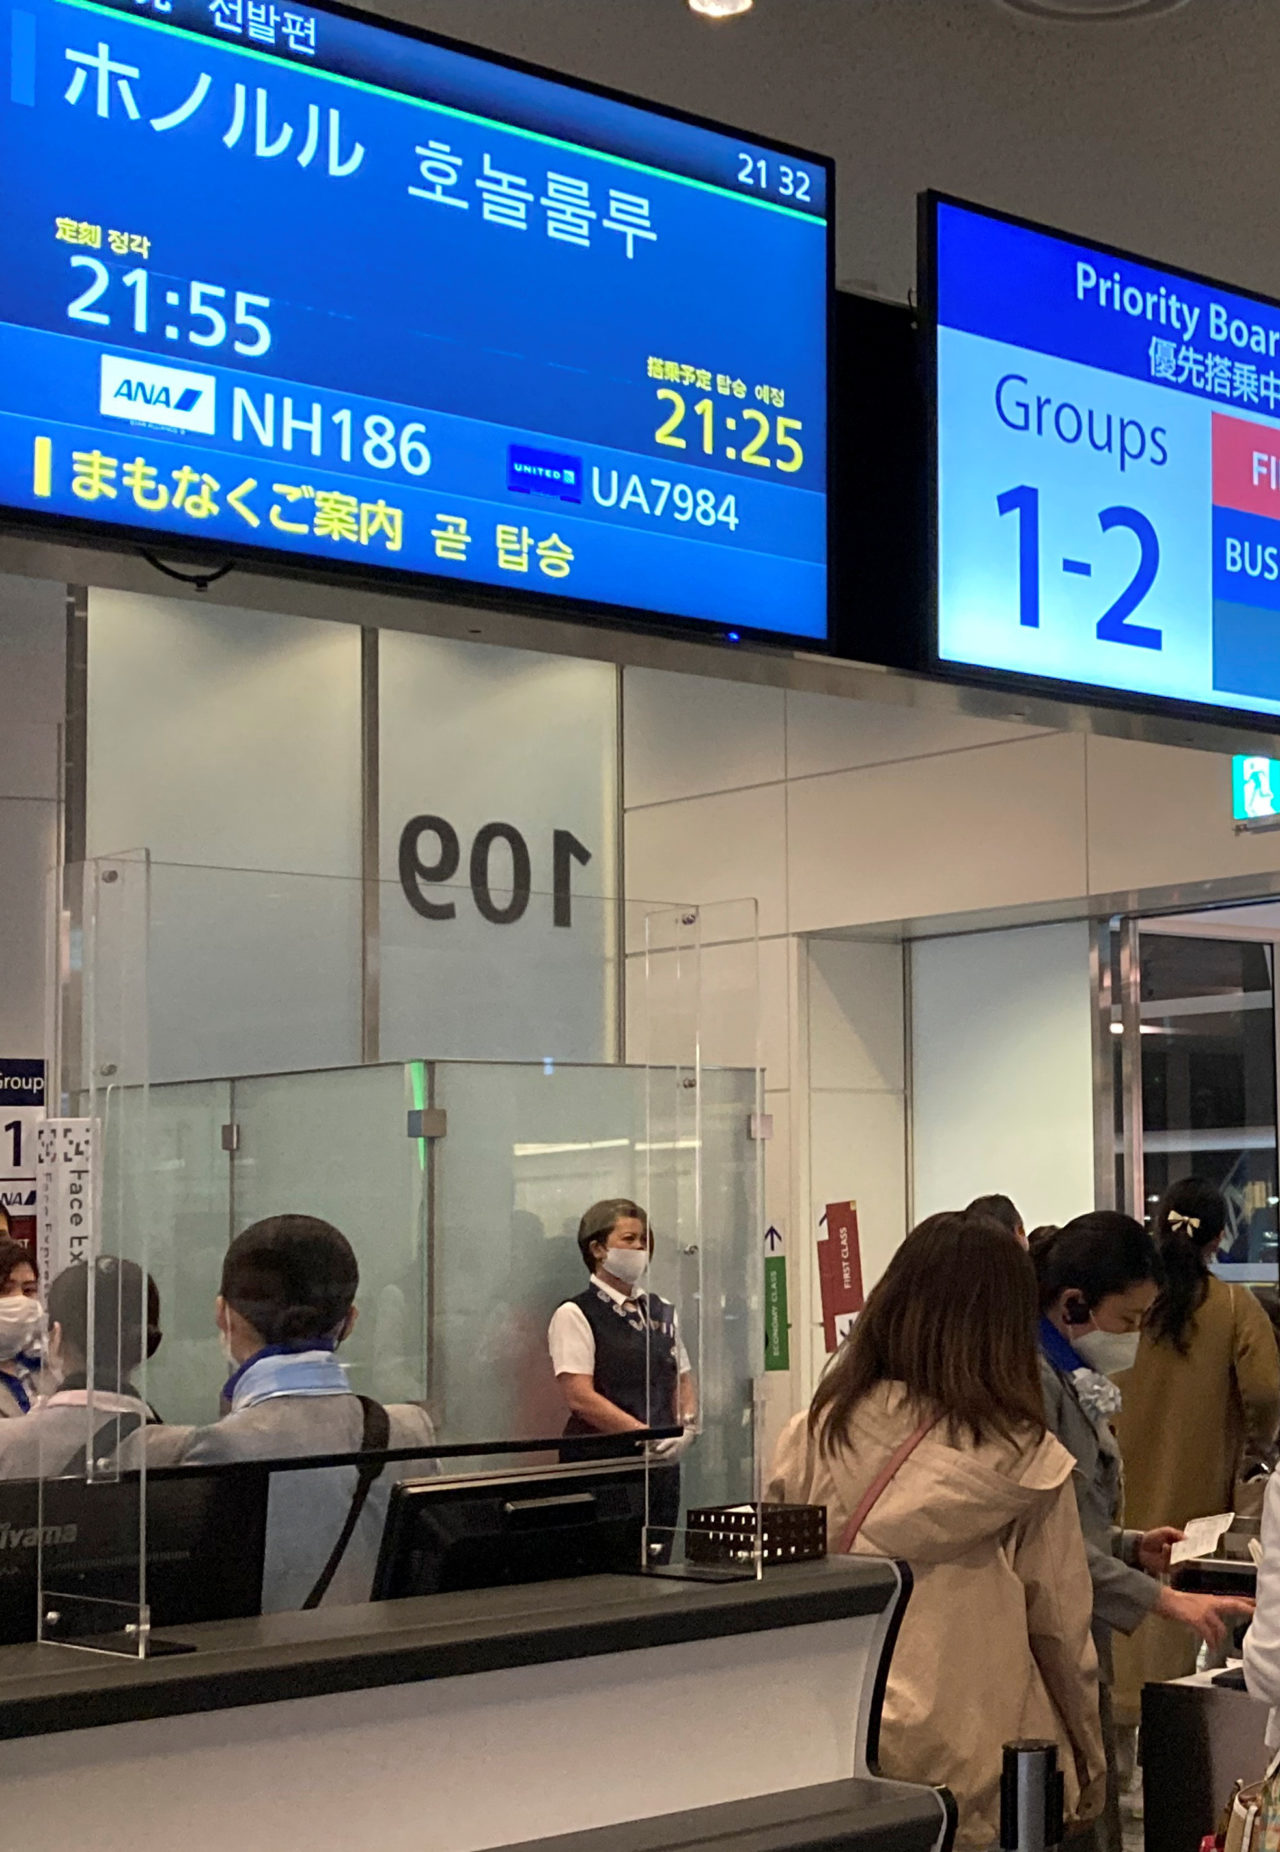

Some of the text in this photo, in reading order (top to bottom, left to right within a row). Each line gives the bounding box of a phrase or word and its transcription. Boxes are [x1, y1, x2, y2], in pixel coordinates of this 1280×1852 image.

[64, 42, 366, 178] ホノルル
[407, 139, 658, 259] 호놀룰루
[737, 152, 811, 202] 21 32
[55, 217, 151, 259] 定刻 정각
[67, 254, 272, 357] 21:55
[1076, 261, 1200, 342] Priority
[113, 378, 171, 409] ANA
[231, 385, 432, 476] NH186
[654, 387, 804, 473] 21:25
[995, 373, 1168, 471] Groups
[71, 448, 575, 578] まもなくご案内 곧 탑승
[514, 463, 561, 480] UNITED
[591, 465, 740, 531] UA7984
[996, 484, 1163, 651] 1-2
[4, 1120, 22, 1167] 1
[839, 1227, 851, 1289] FIRST CLASS
[770, 1271, 780, 1357] ECONOMY CLASS
